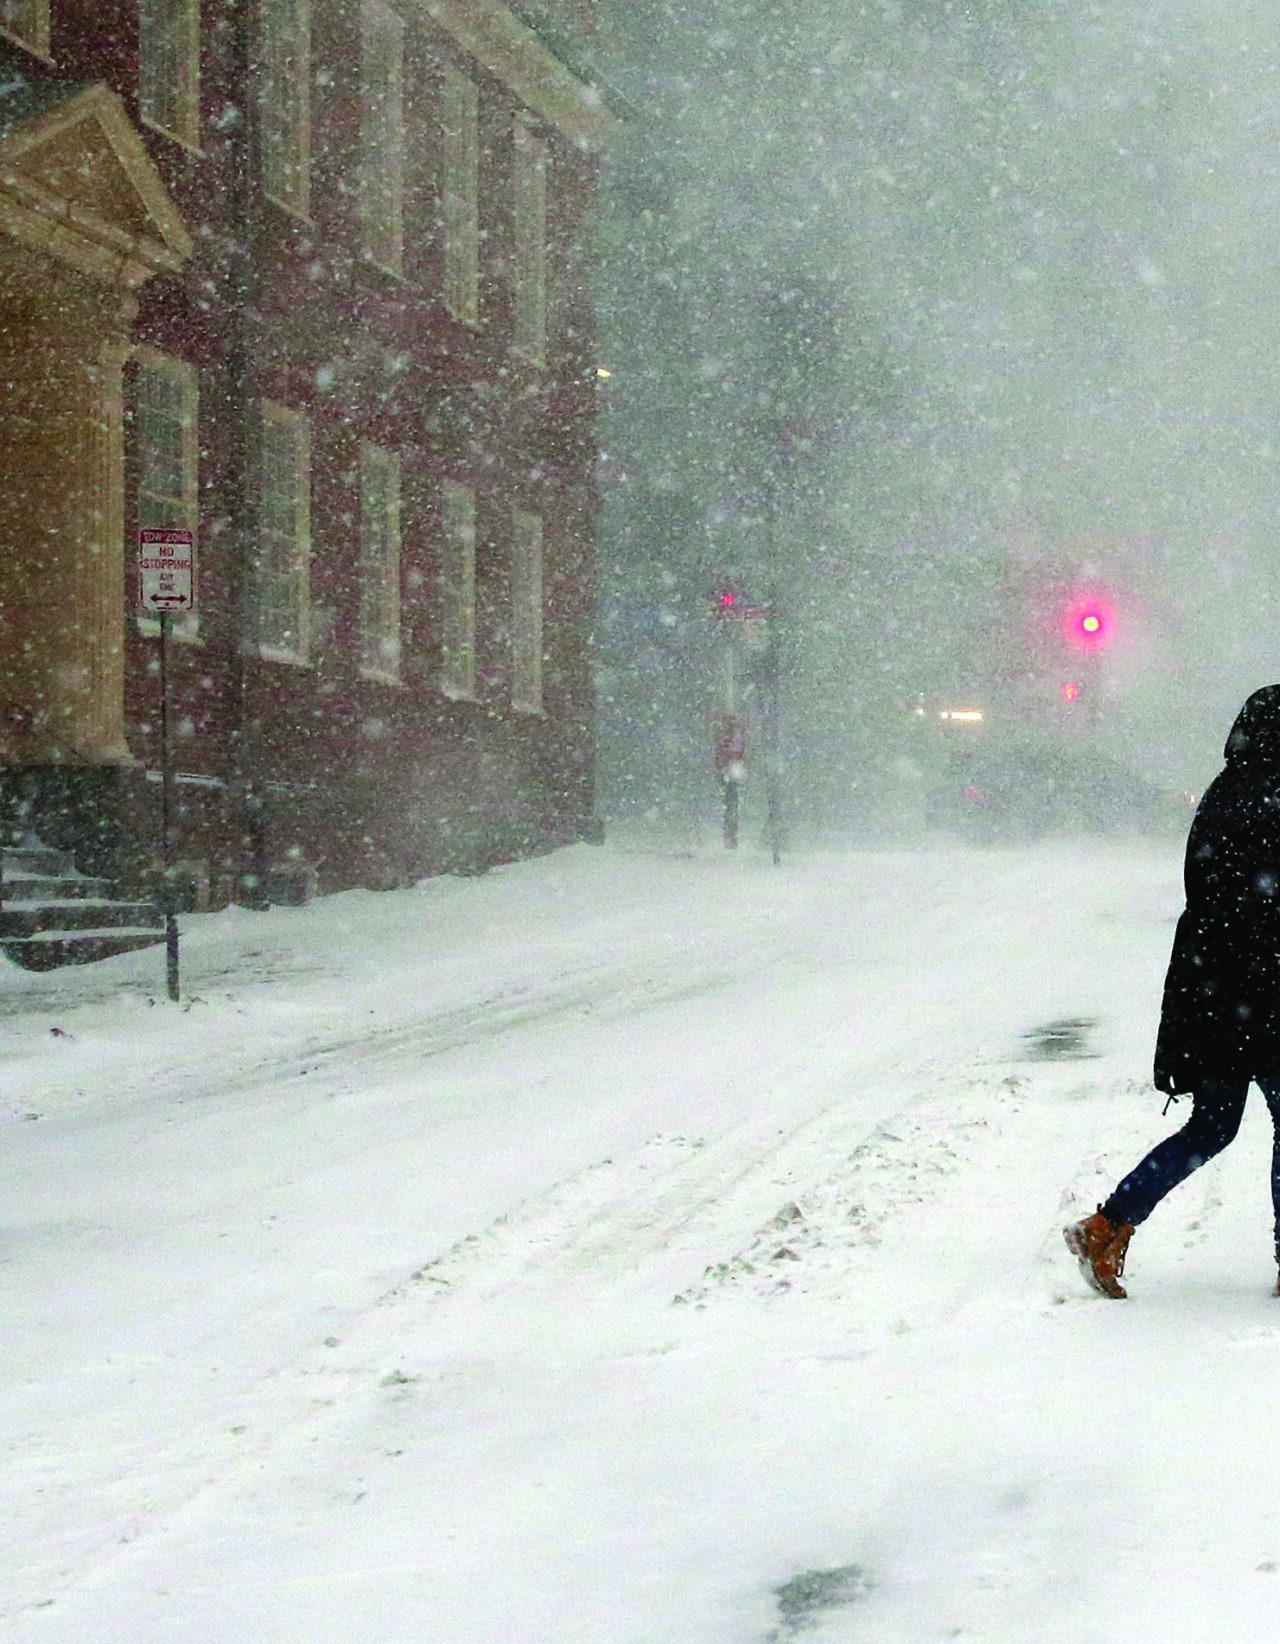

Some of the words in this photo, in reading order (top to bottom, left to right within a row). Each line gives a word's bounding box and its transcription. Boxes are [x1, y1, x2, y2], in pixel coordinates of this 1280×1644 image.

[143, 531, 162, 541] TOW
[166, 531, 192, 541] ZONE
[159, 547, 174, 557] NO
[143, 558, 191, 570] STOPPING
[160, 573, 174, 581] ANY
